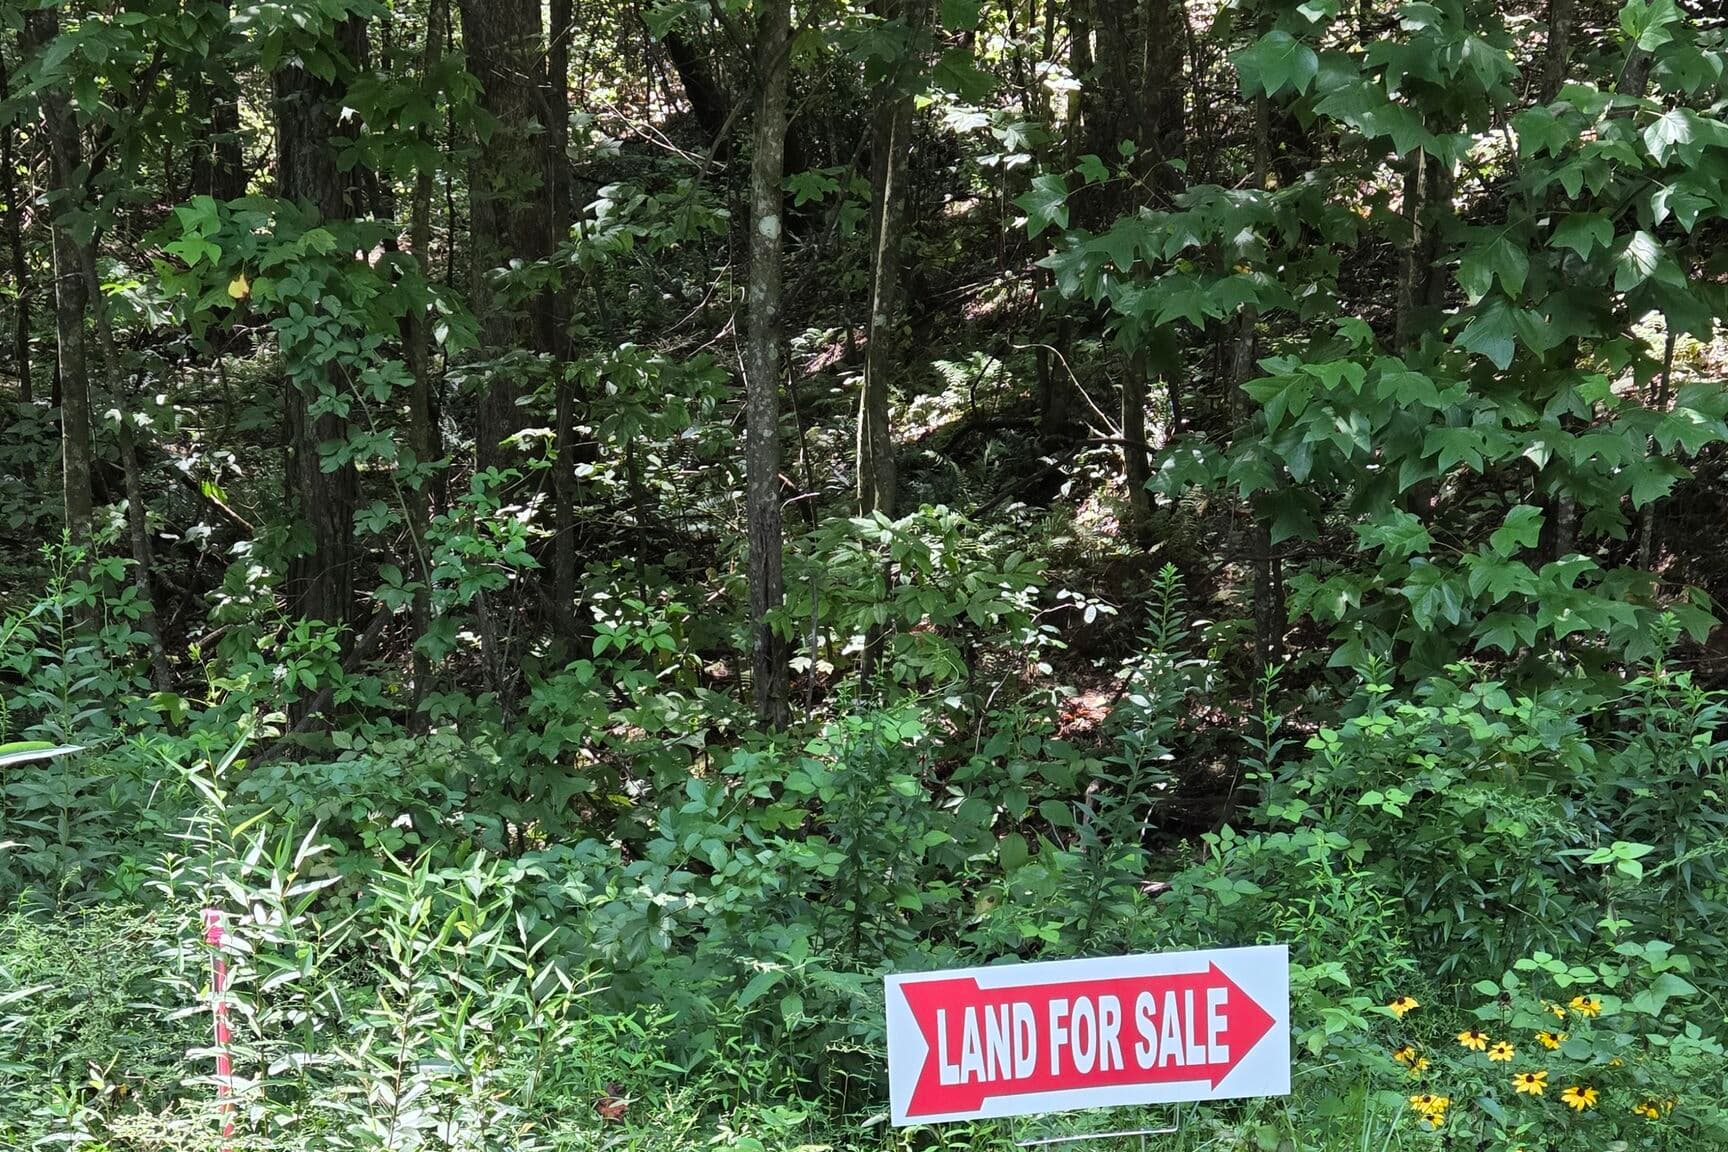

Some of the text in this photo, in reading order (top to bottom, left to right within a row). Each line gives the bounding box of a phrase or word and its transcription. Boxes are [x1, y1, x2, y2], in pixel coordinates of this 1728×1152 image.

[937, 986, 1230, 1086] LAND FOR SALE
